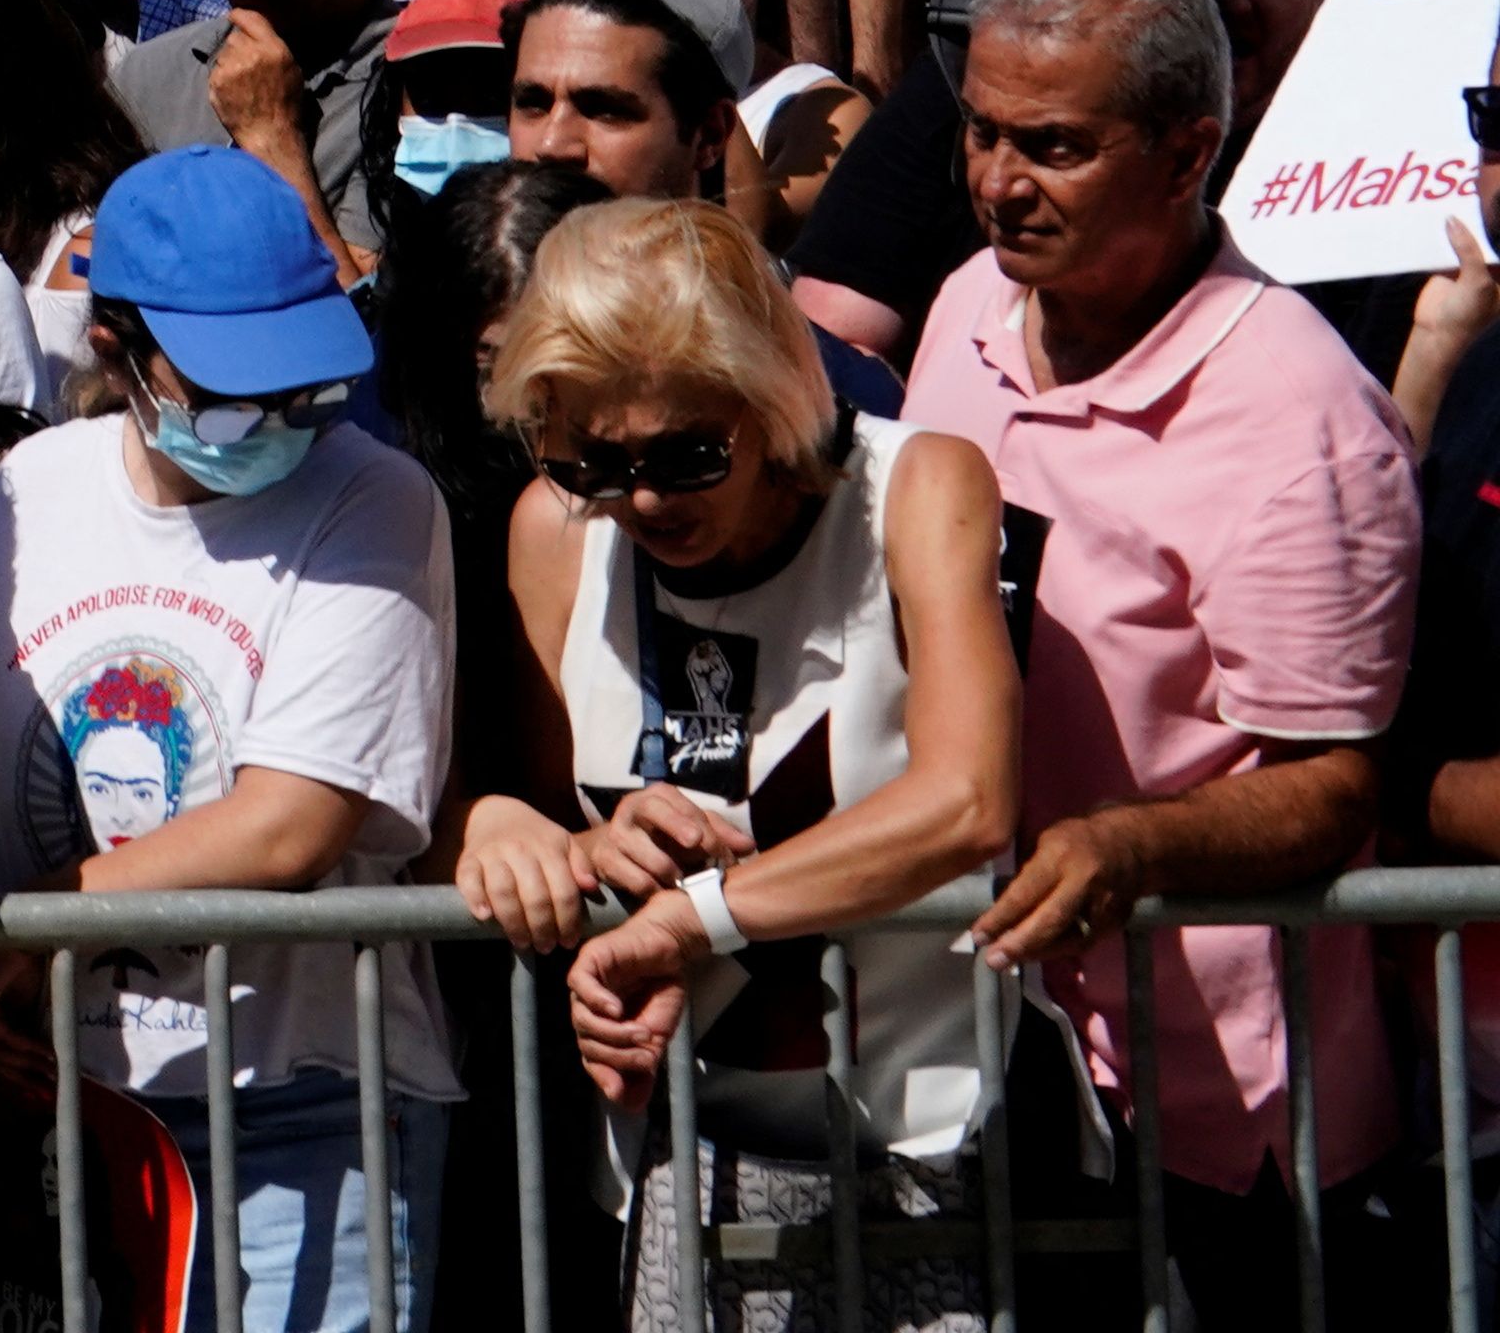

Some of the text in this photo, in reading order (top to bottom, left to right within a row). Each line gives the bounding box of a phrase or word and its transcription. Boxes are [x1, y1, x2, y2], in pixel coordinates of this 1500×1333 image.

[66, 584, 149, 627] APOLOGISE
[152, 590, 186, 615] FOR
[189, 600, 225, 630] WHO
